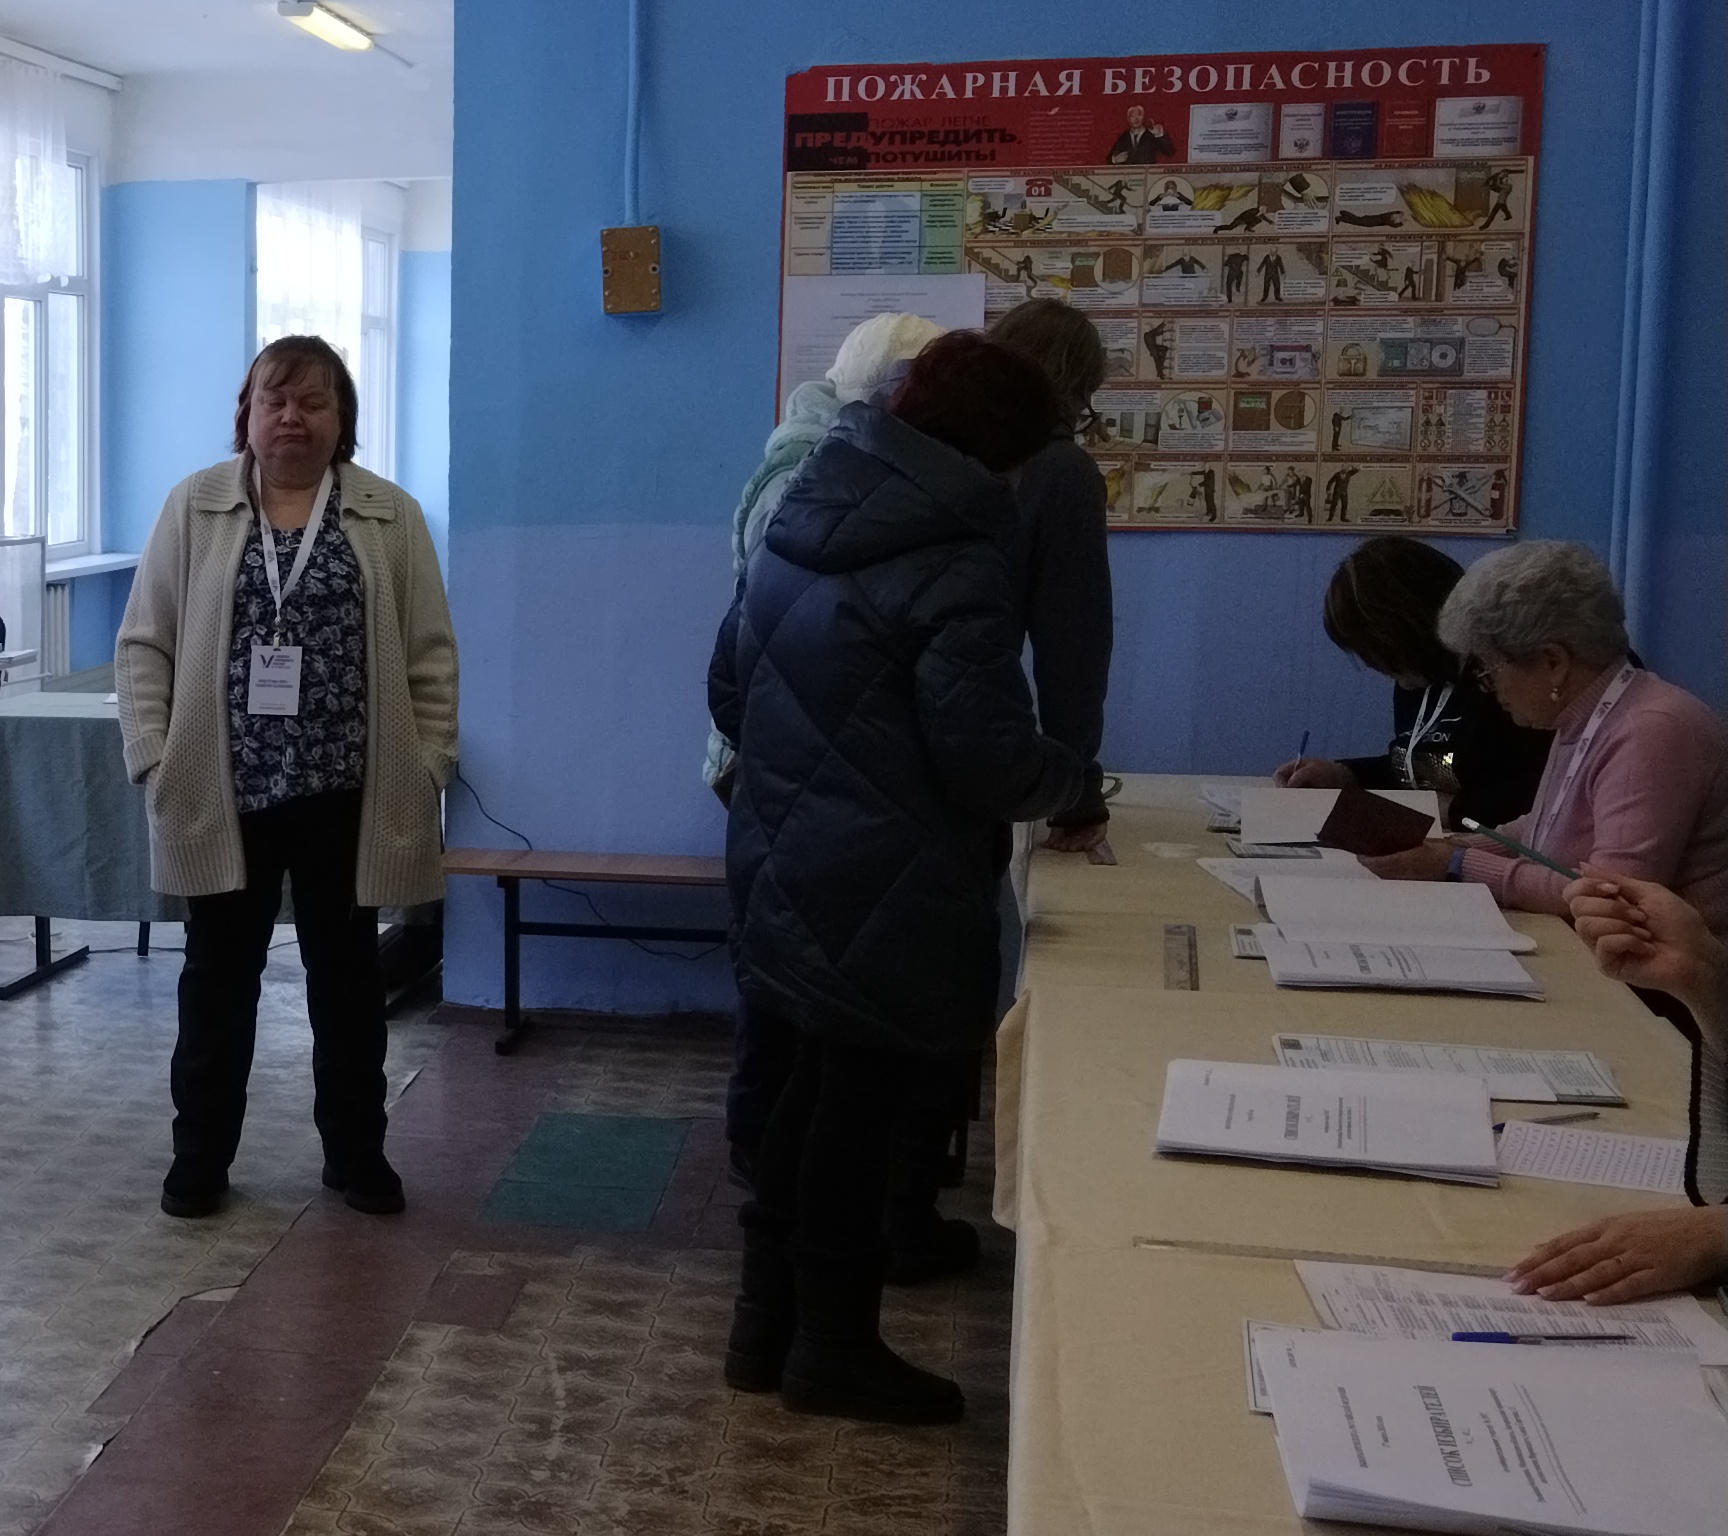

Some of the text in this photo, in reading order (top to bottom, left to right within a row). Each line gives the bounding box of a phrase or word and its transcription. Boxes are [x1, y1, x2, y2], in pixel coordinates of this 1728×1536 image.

[825, 57, 1491, 102] ПОЖАРНАЯ БЕЗОПАСНОСТЬ
[868, 117, 933, 129] ПОЖАР
[795, 128, 1022, 148] ПРЕДУПРЕДИТЬ,
[867, 149, 996, 163] ПОТУШИТЬ!
[1031, 186, 1045, 196] 01
[1412, 1385, 1473, 1486] СПИСОК ИЗБИРАТЕЛЕЙ
